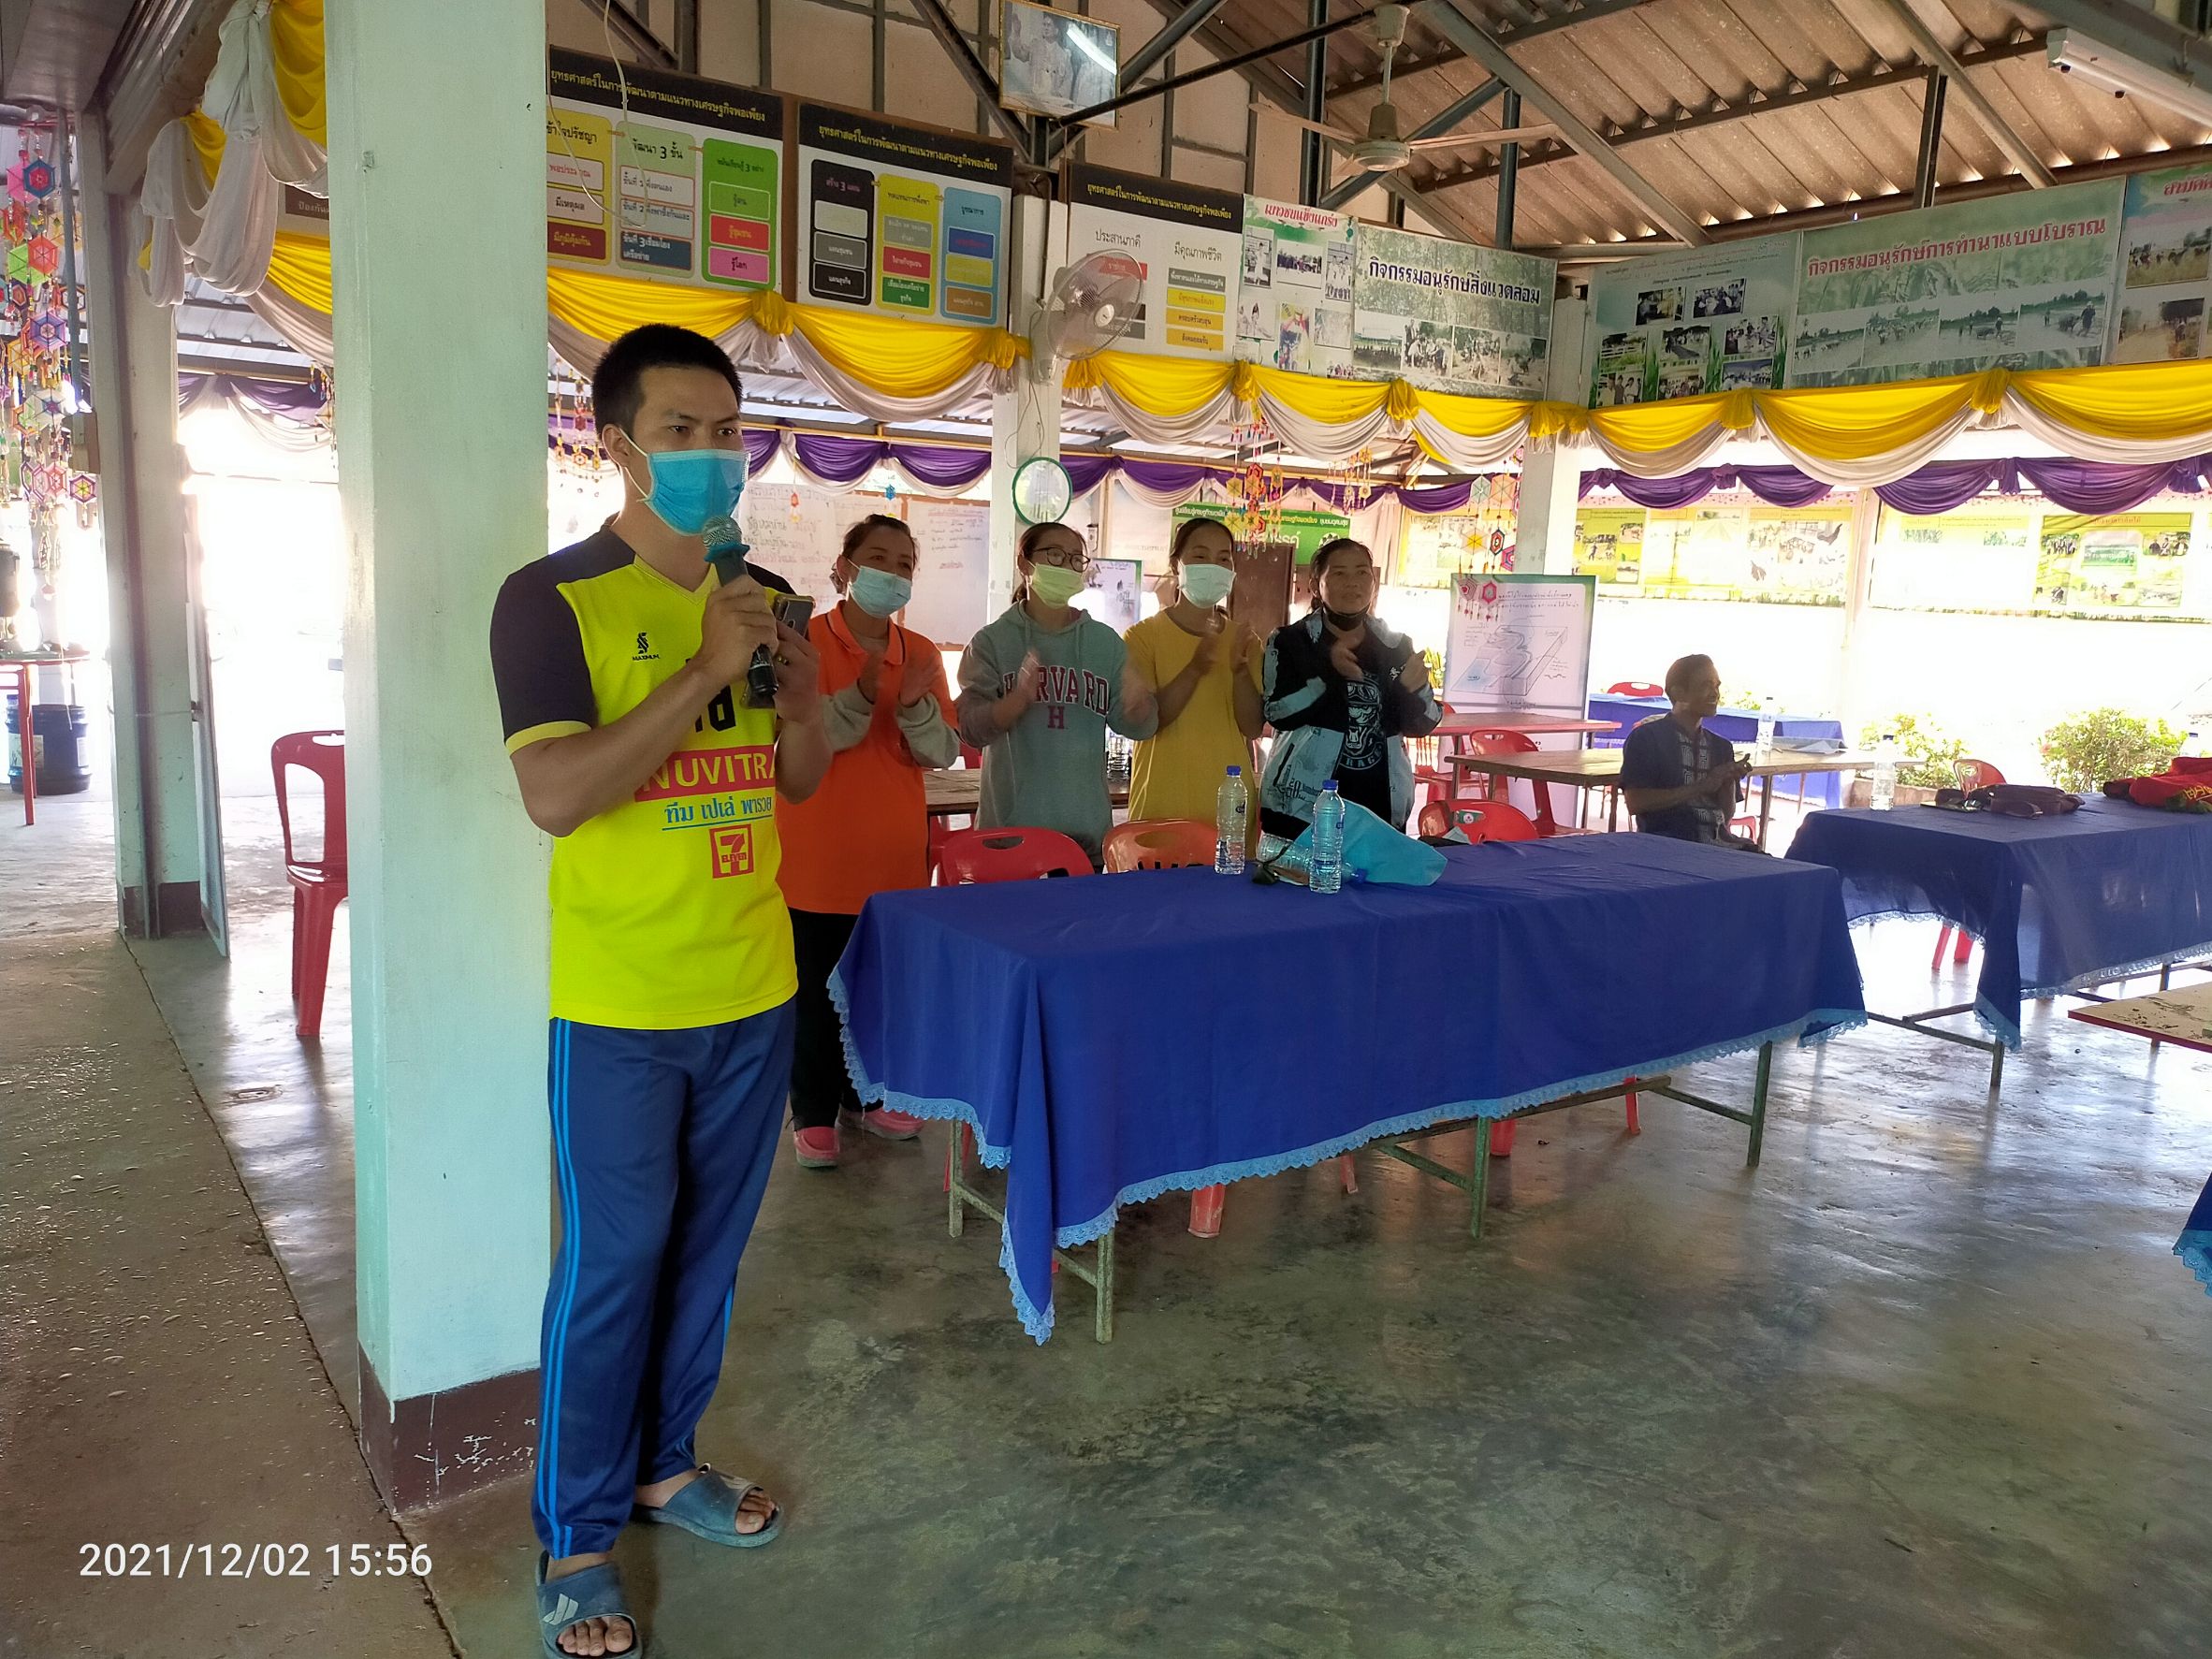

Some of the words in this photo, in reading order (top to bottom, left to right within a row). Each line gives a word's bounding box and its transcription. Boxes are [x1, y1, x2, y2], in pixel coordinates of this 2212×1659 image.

[546, 121, 597, 144] ข้าใจปรัชญา
[660, 146, 667, 159] 3
[549, 164, 591, 178] พอประาณ
[840, 182, 846, 192] 3
[1809, 217, 2105, 277] กิจกรรมอนุรักษ์การทำนาแบบโบราณ
[1369, 256, 1540, 305] กิจกรรมอนุรักษ์สิ่งแวดล้อม
[1003, 665, 1110, 718] HRVARD
[1047, 706, 1065, 730] H
[664, 801, 693, 823] ทีม
[701, 795, 735, 820] เปเล่
